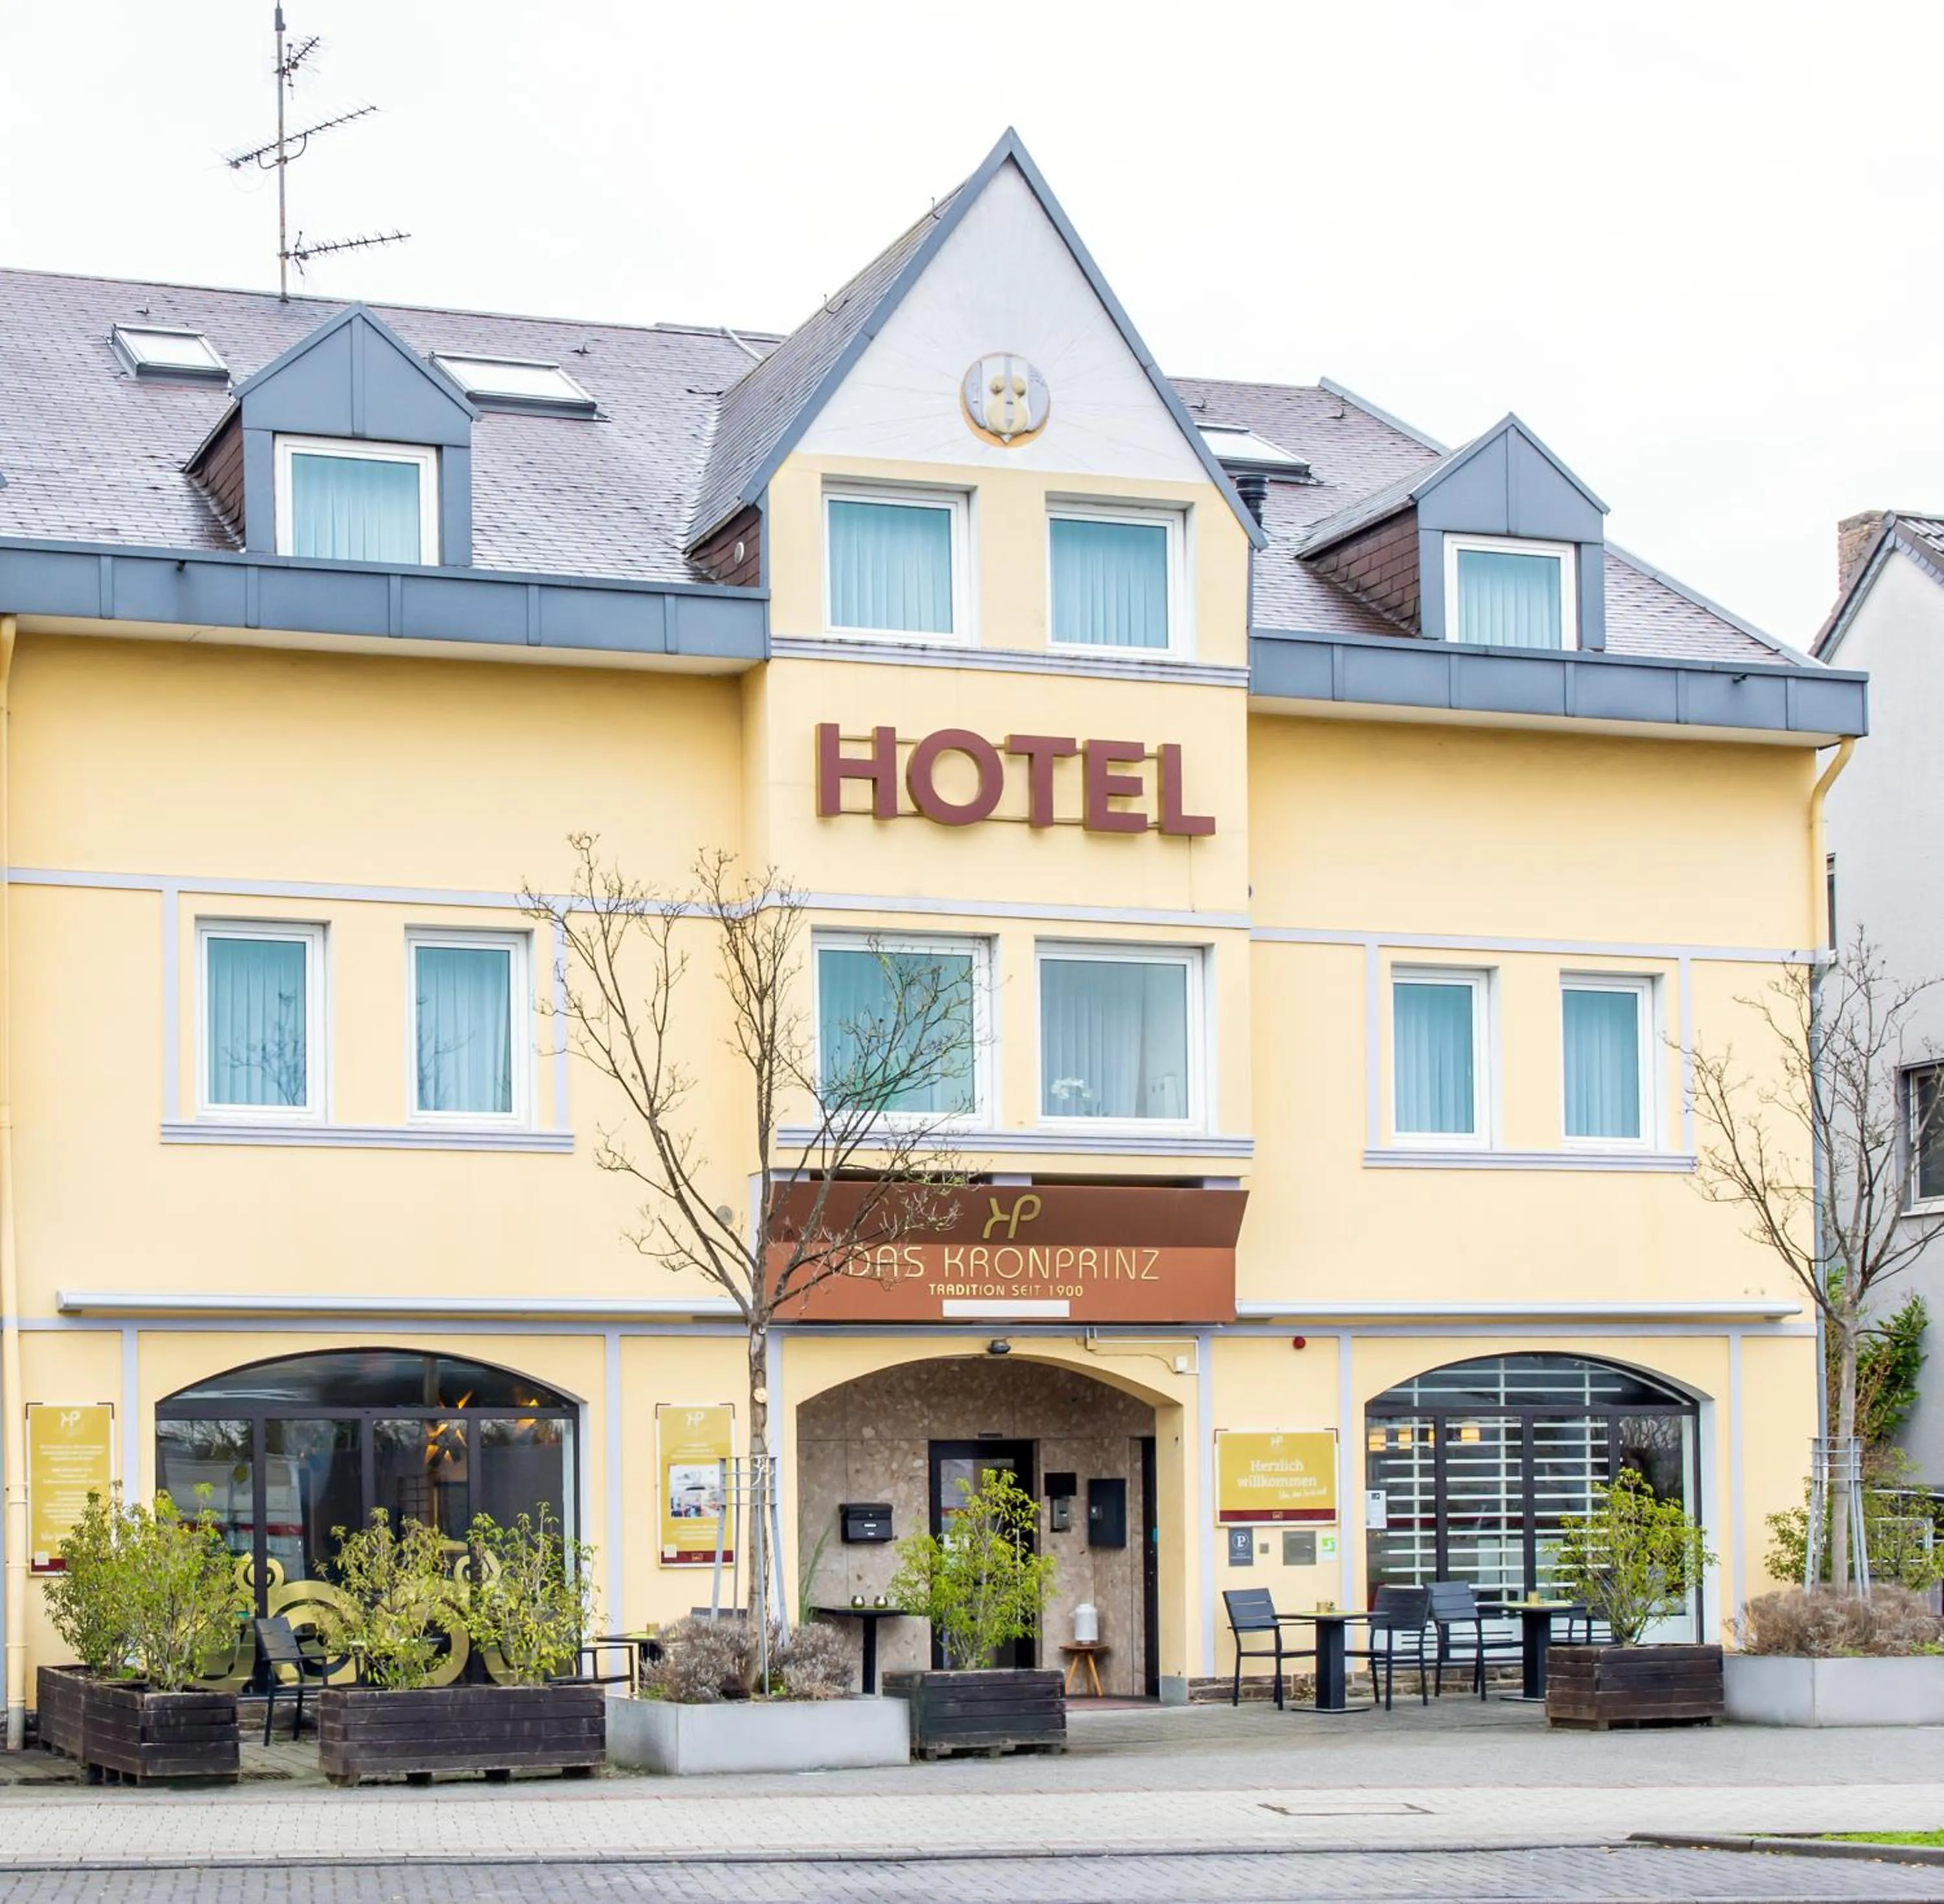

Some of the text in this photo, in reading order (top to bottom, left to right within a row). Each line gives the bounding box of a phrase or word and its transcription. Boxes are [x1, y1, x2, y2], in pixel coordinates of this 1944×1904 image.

[815, 723, 1216, 836] HOTEL
[848, 1245, 1161, 1281] DAS KRONPRINZ
[928, 1283, 1083, 1297] TRADITION SEIT 1900
[1251, 1459, 1304, 1473] Herzlich
[1237, 1474, 1317, 1489] willkommen
